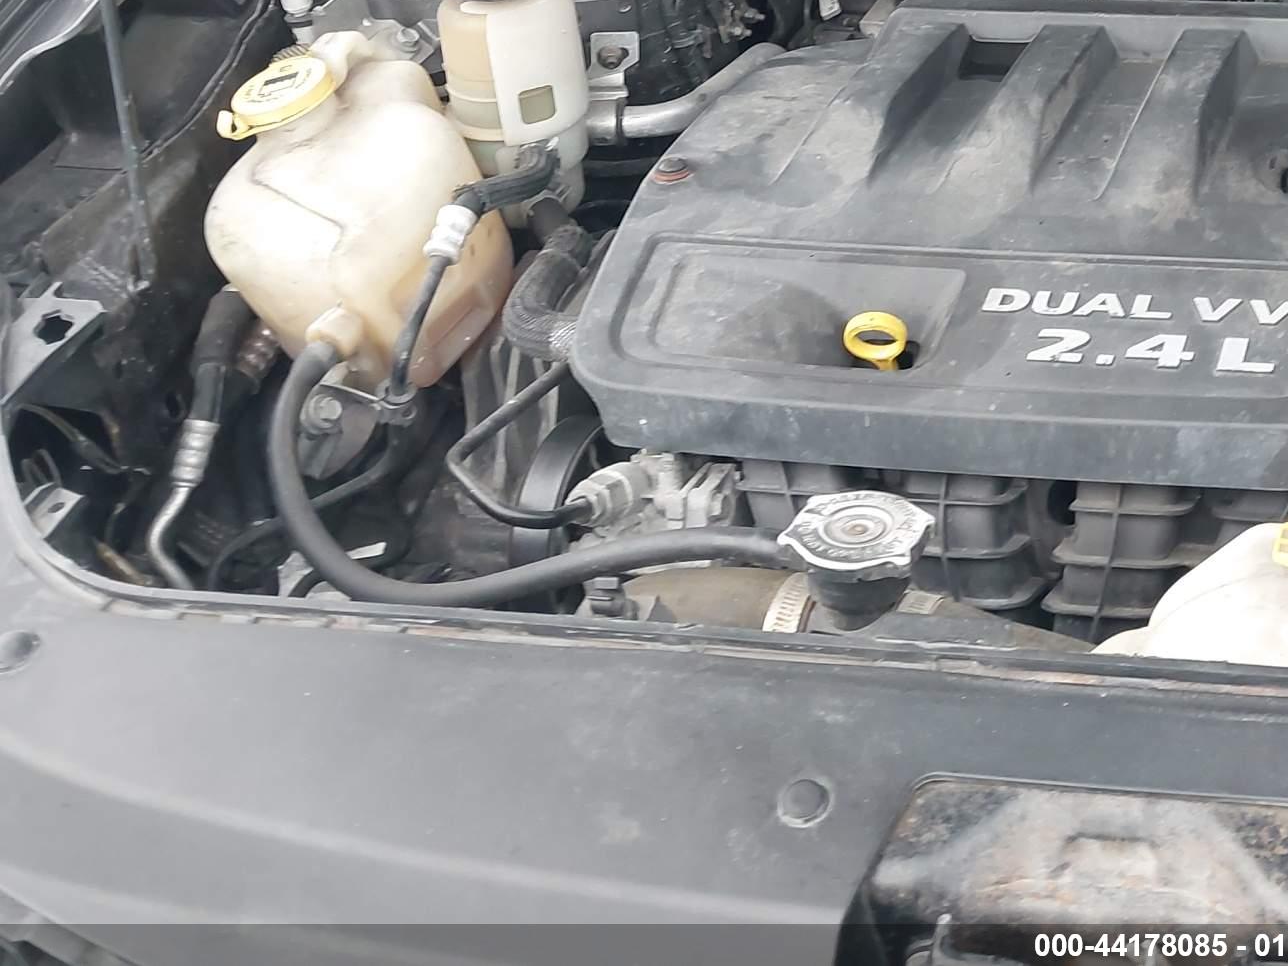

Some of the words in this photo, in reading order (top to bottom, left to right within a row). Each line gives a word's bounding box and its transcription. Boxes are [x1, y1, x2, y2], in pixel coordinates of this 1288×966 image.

[982, 288, 1172, 319] DUAL
[1026, 328, 1195, 369] 2.4
[1216, 337, 1276, 374] L
